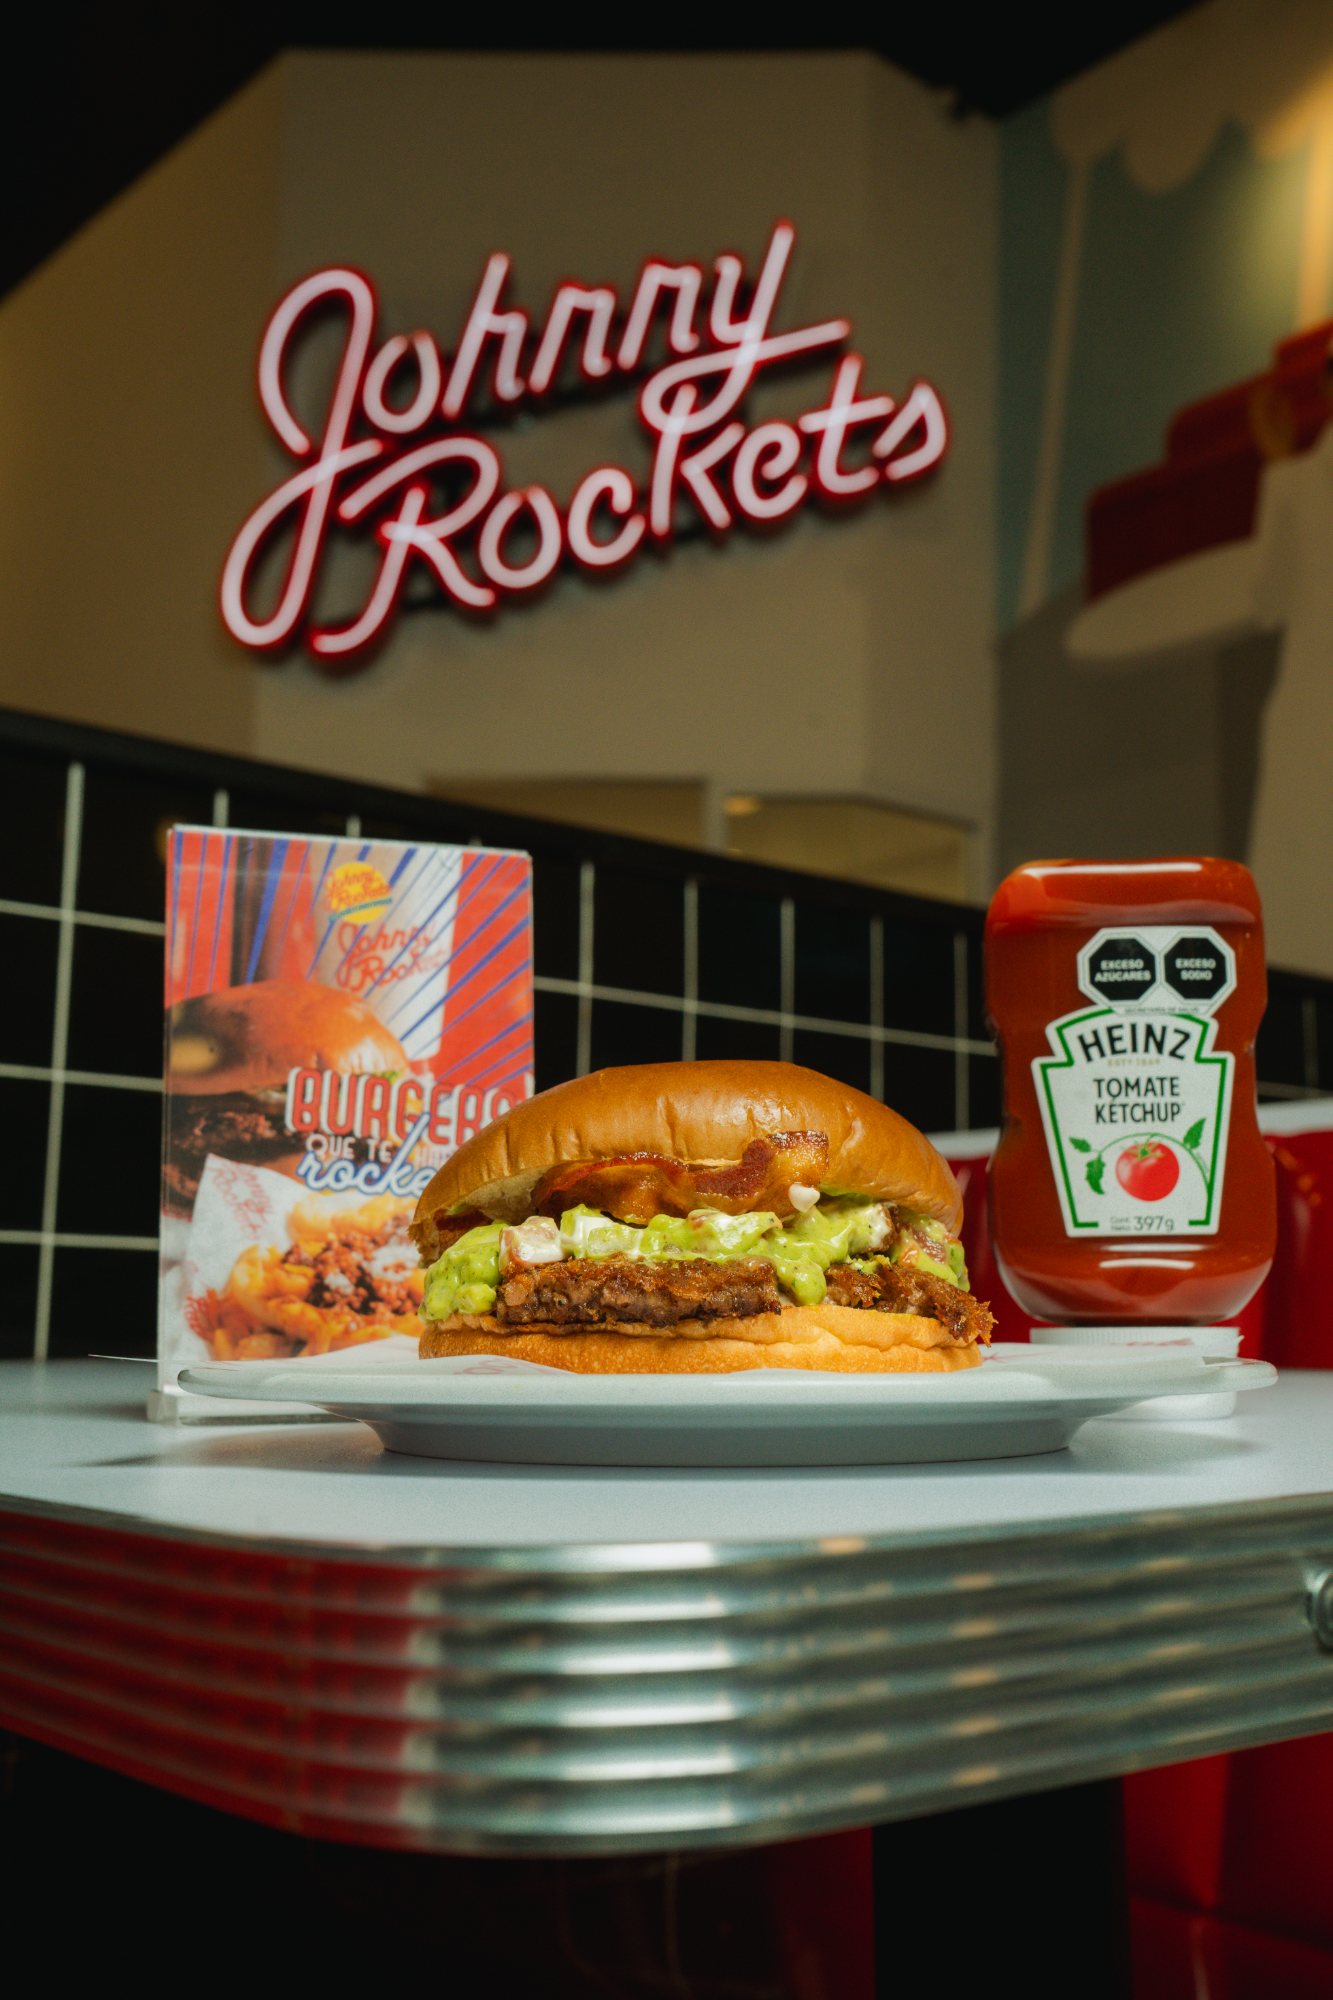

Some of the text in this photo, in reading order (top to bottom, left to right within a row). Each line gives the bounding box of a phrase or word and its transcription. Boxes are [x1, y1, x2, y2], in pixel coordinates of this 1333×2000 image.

[221, 218, 851, 648] Johnny
[311, 352, 950, 656] Rockets
[1100, 958, 1144, 970] EXCESO
[1175, 958, 1216, 969] EXCESO
[1180, 970, 1213, 981] SODIO
[1077, 1022, 1191, 1063] HEINZ
[1093, 1076, 1180, 1098] TOMATE
[1095, 1102, 1181, 1123] KETCHUP
[306, 1133, 355, 1160] QUE
[367, 1139, 393, 1164] TE
[1133, 1215, 1174, 1233] 397g
